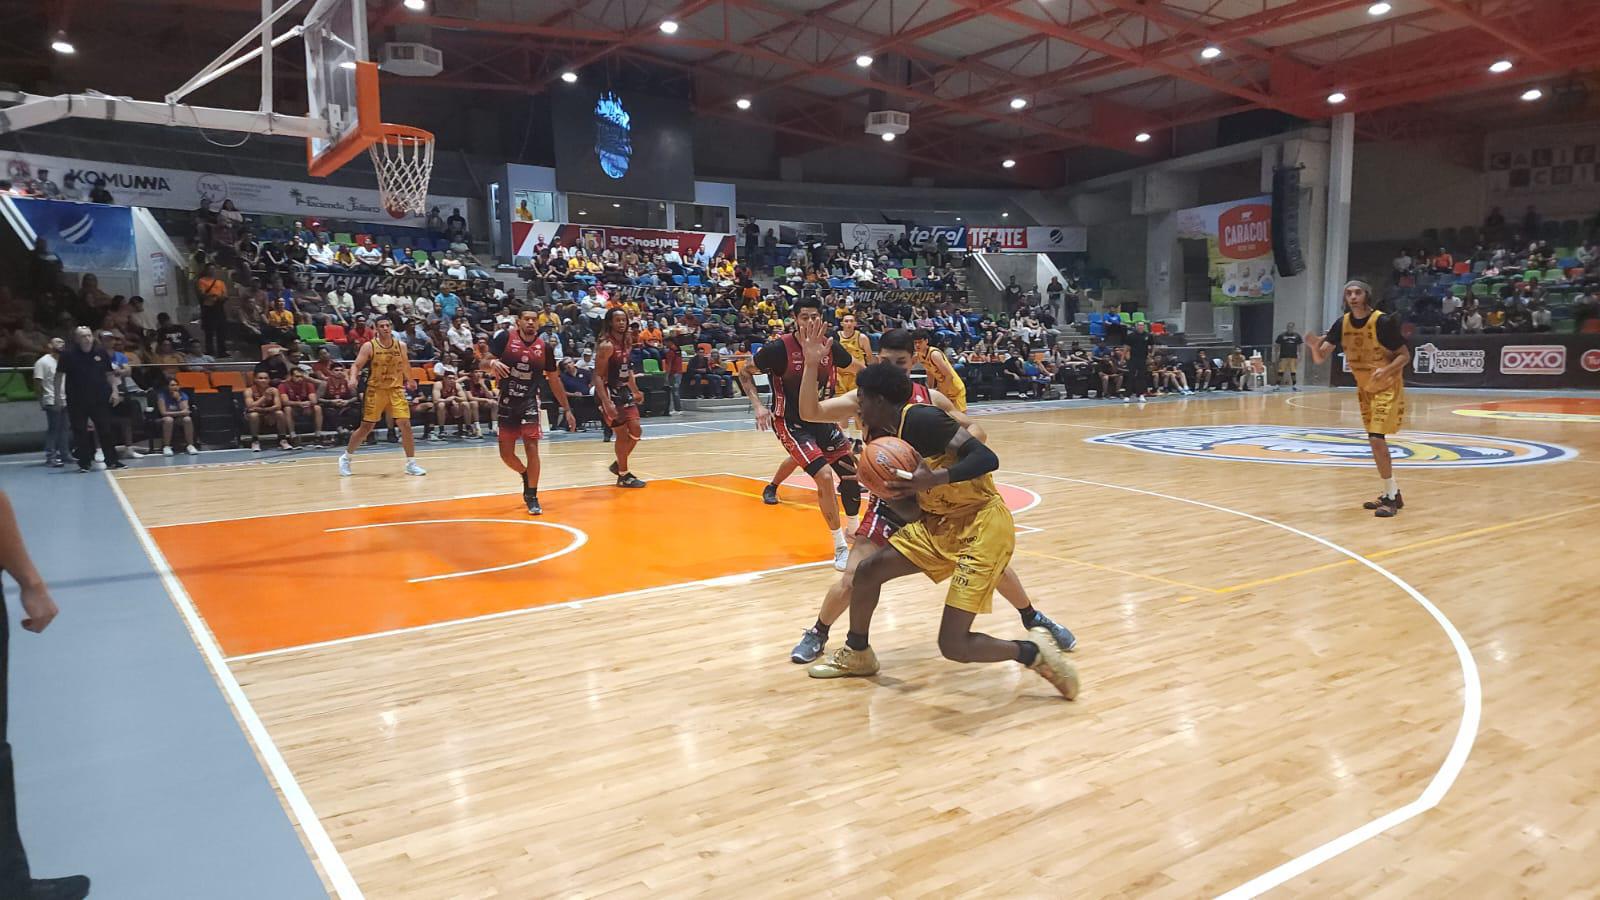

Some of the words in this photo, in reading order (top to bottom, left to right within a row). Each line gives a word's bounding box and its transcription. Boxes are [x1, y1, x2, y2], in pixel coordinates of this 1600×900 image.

[69, 168, 171, 191] KOMUNNA
[1224, 221, 1268, 247] CARACOL
[610, 235, 680, 249] BCSnosUNE
[1436, 350, 1484, 358] GASOLINERAS
[1503, 352, 1562, 368] OXXO
[1435, 357, 1483, 369] POLANCO
